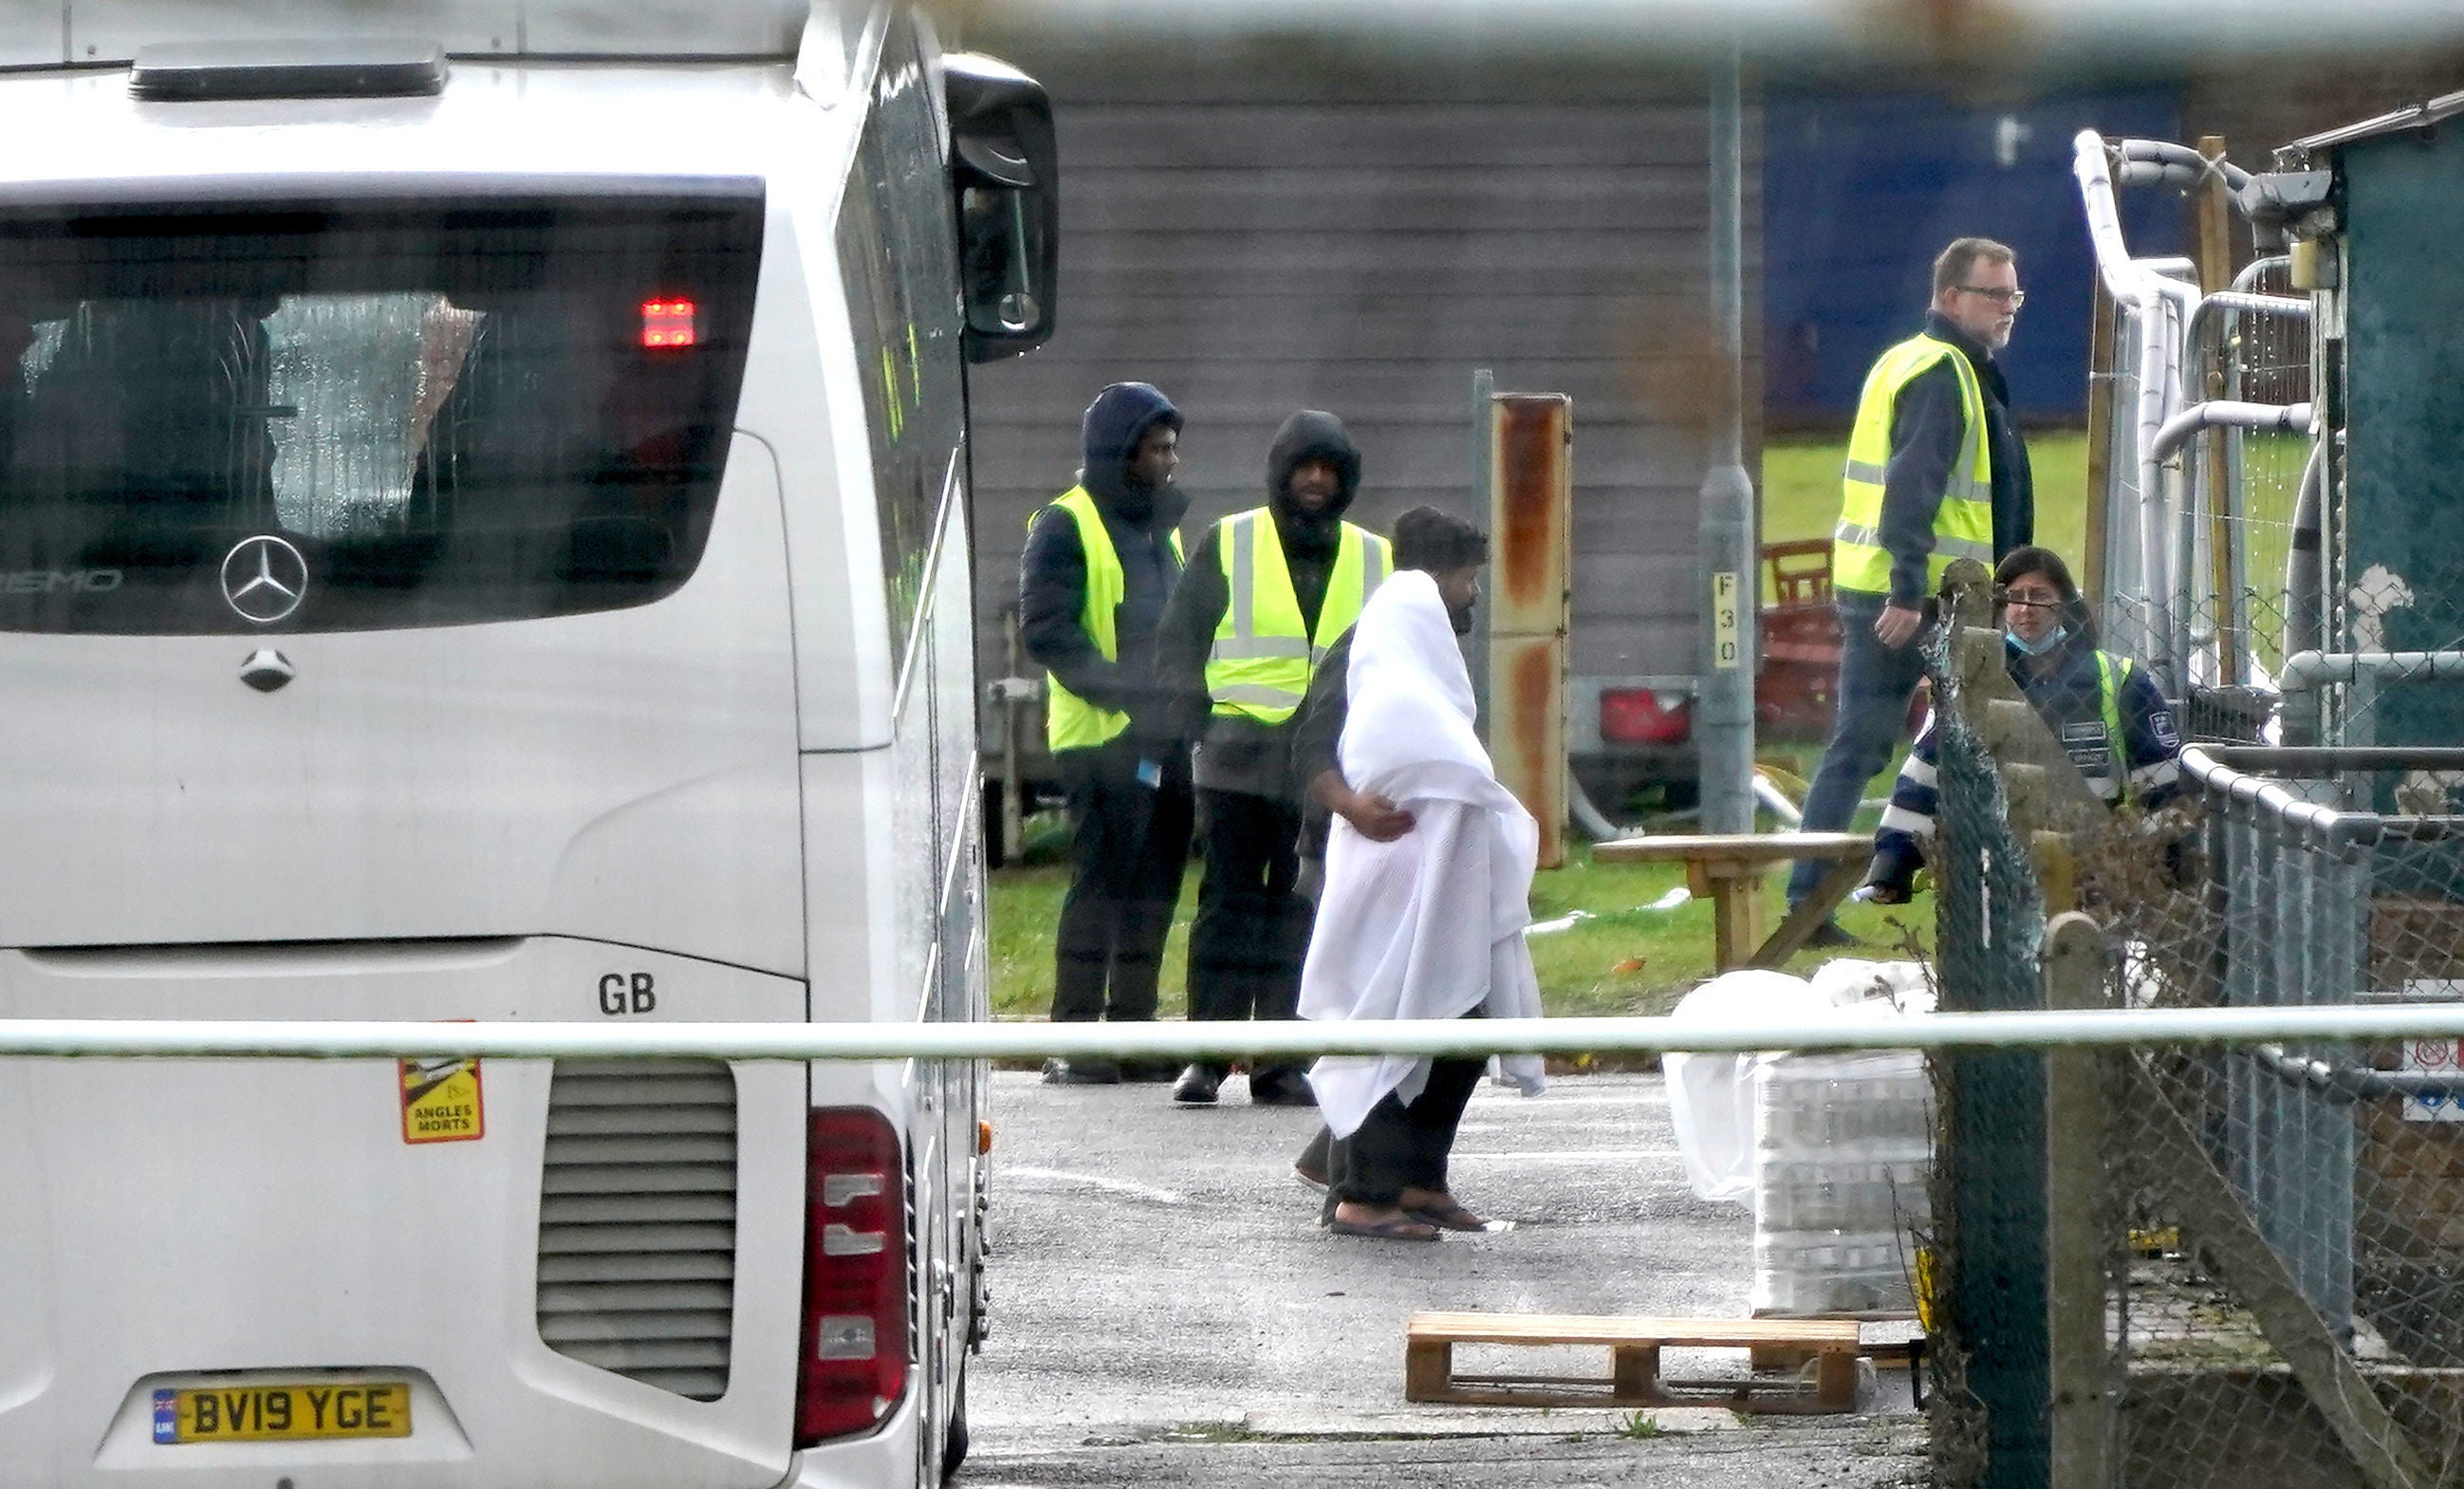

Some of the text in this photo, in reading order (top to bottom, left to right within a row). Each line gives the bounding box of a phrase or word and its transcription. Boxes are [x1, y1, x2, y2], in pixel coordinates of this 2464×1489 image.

[599, 972, 656, 1015] GB
[415, 1104, 472, 1119] ANGLES
[418, 1119, 470, 1131] MORTS
[195, 1388, 392, 1434] BV19 YGE
